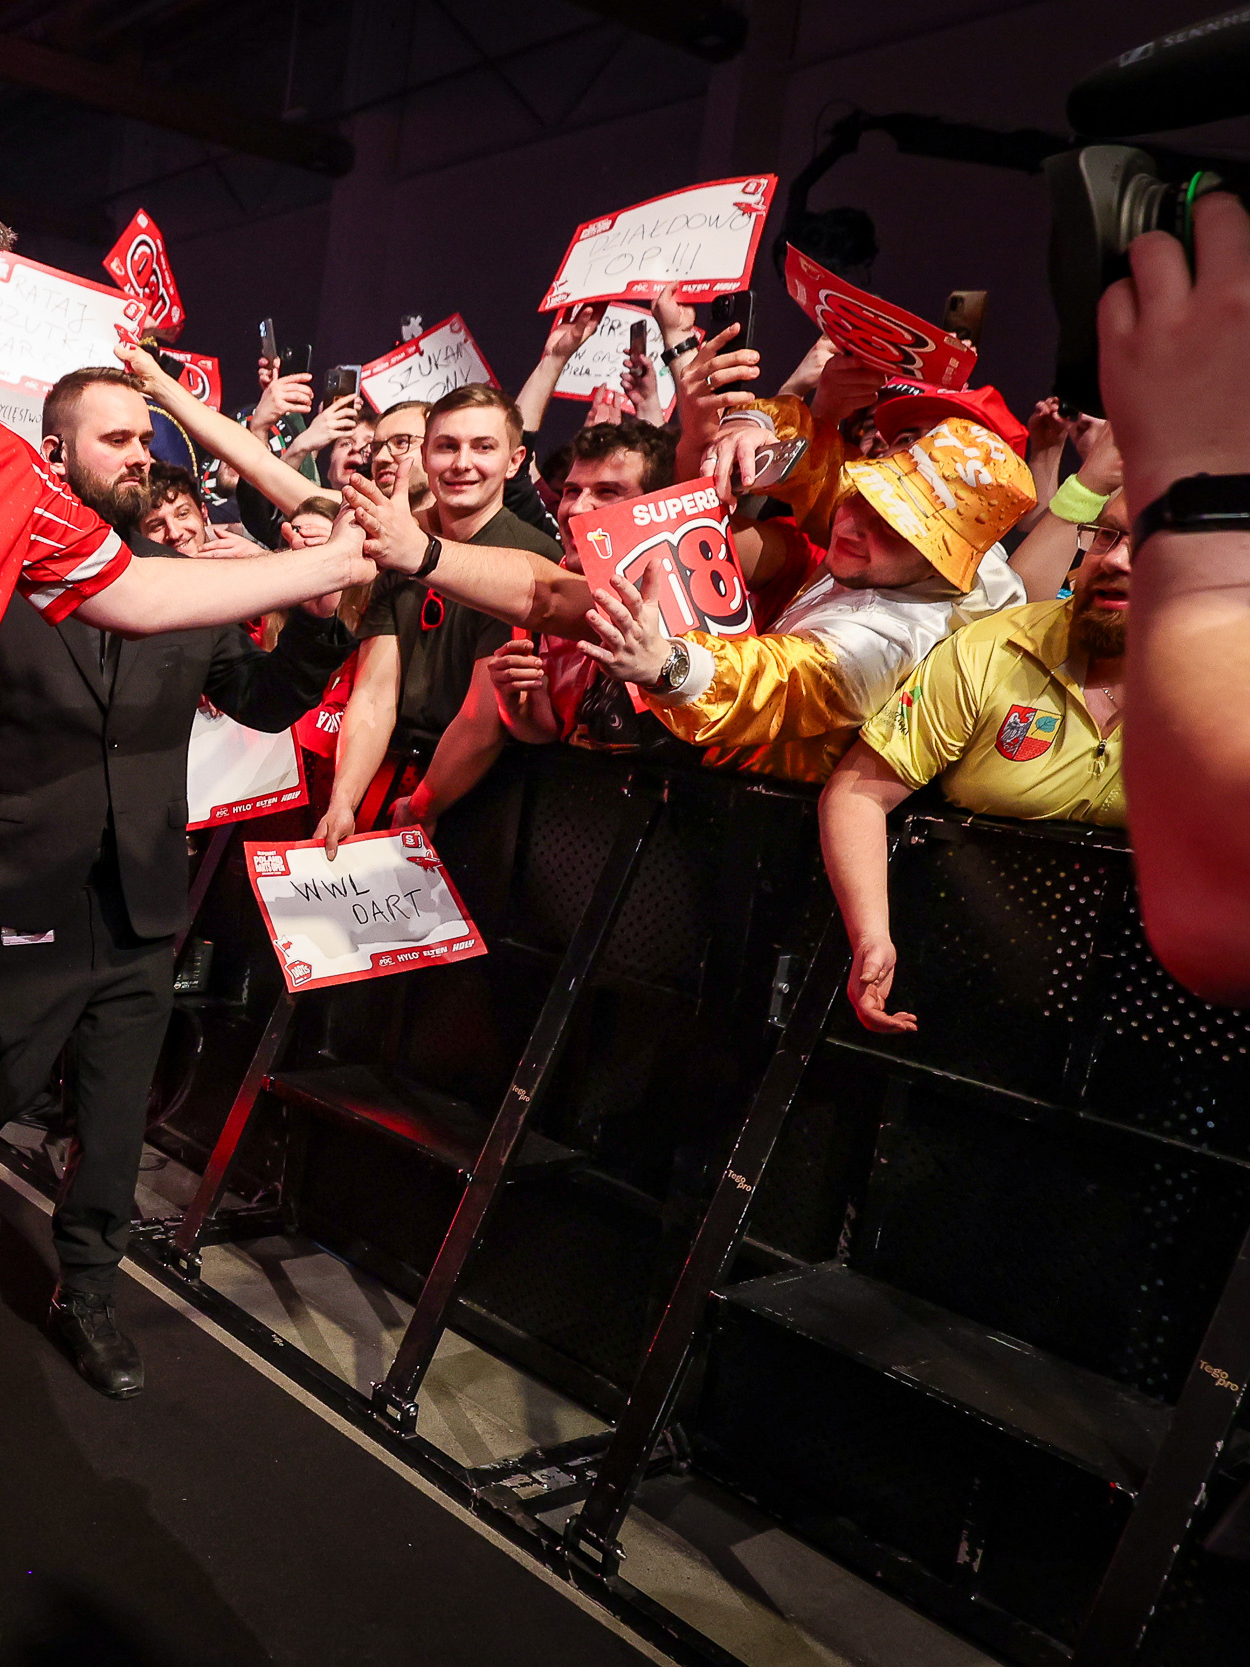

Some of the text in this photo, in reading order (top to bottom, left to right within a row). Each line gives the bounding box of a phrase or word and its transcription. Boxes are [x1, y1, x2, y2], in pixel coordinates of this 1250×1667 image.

[412, 365, 472, 402] ONY
[632, 487, 721, 526] SUPERB
[617, 518, 751, 637] 18
[232, 803, 253, 814] HYLO
[256, 797, 278, 807] ELTEN
[290, 874, 370, 902] WWL
[352, 889, 422, 925] DART
[397, 952, 419, 962] HYLO
[422, 946, 448, 956] ELTEN
[1200, 1360, 1229, 1379] Tego
[1215, 1378, 1239, 1392] pro
